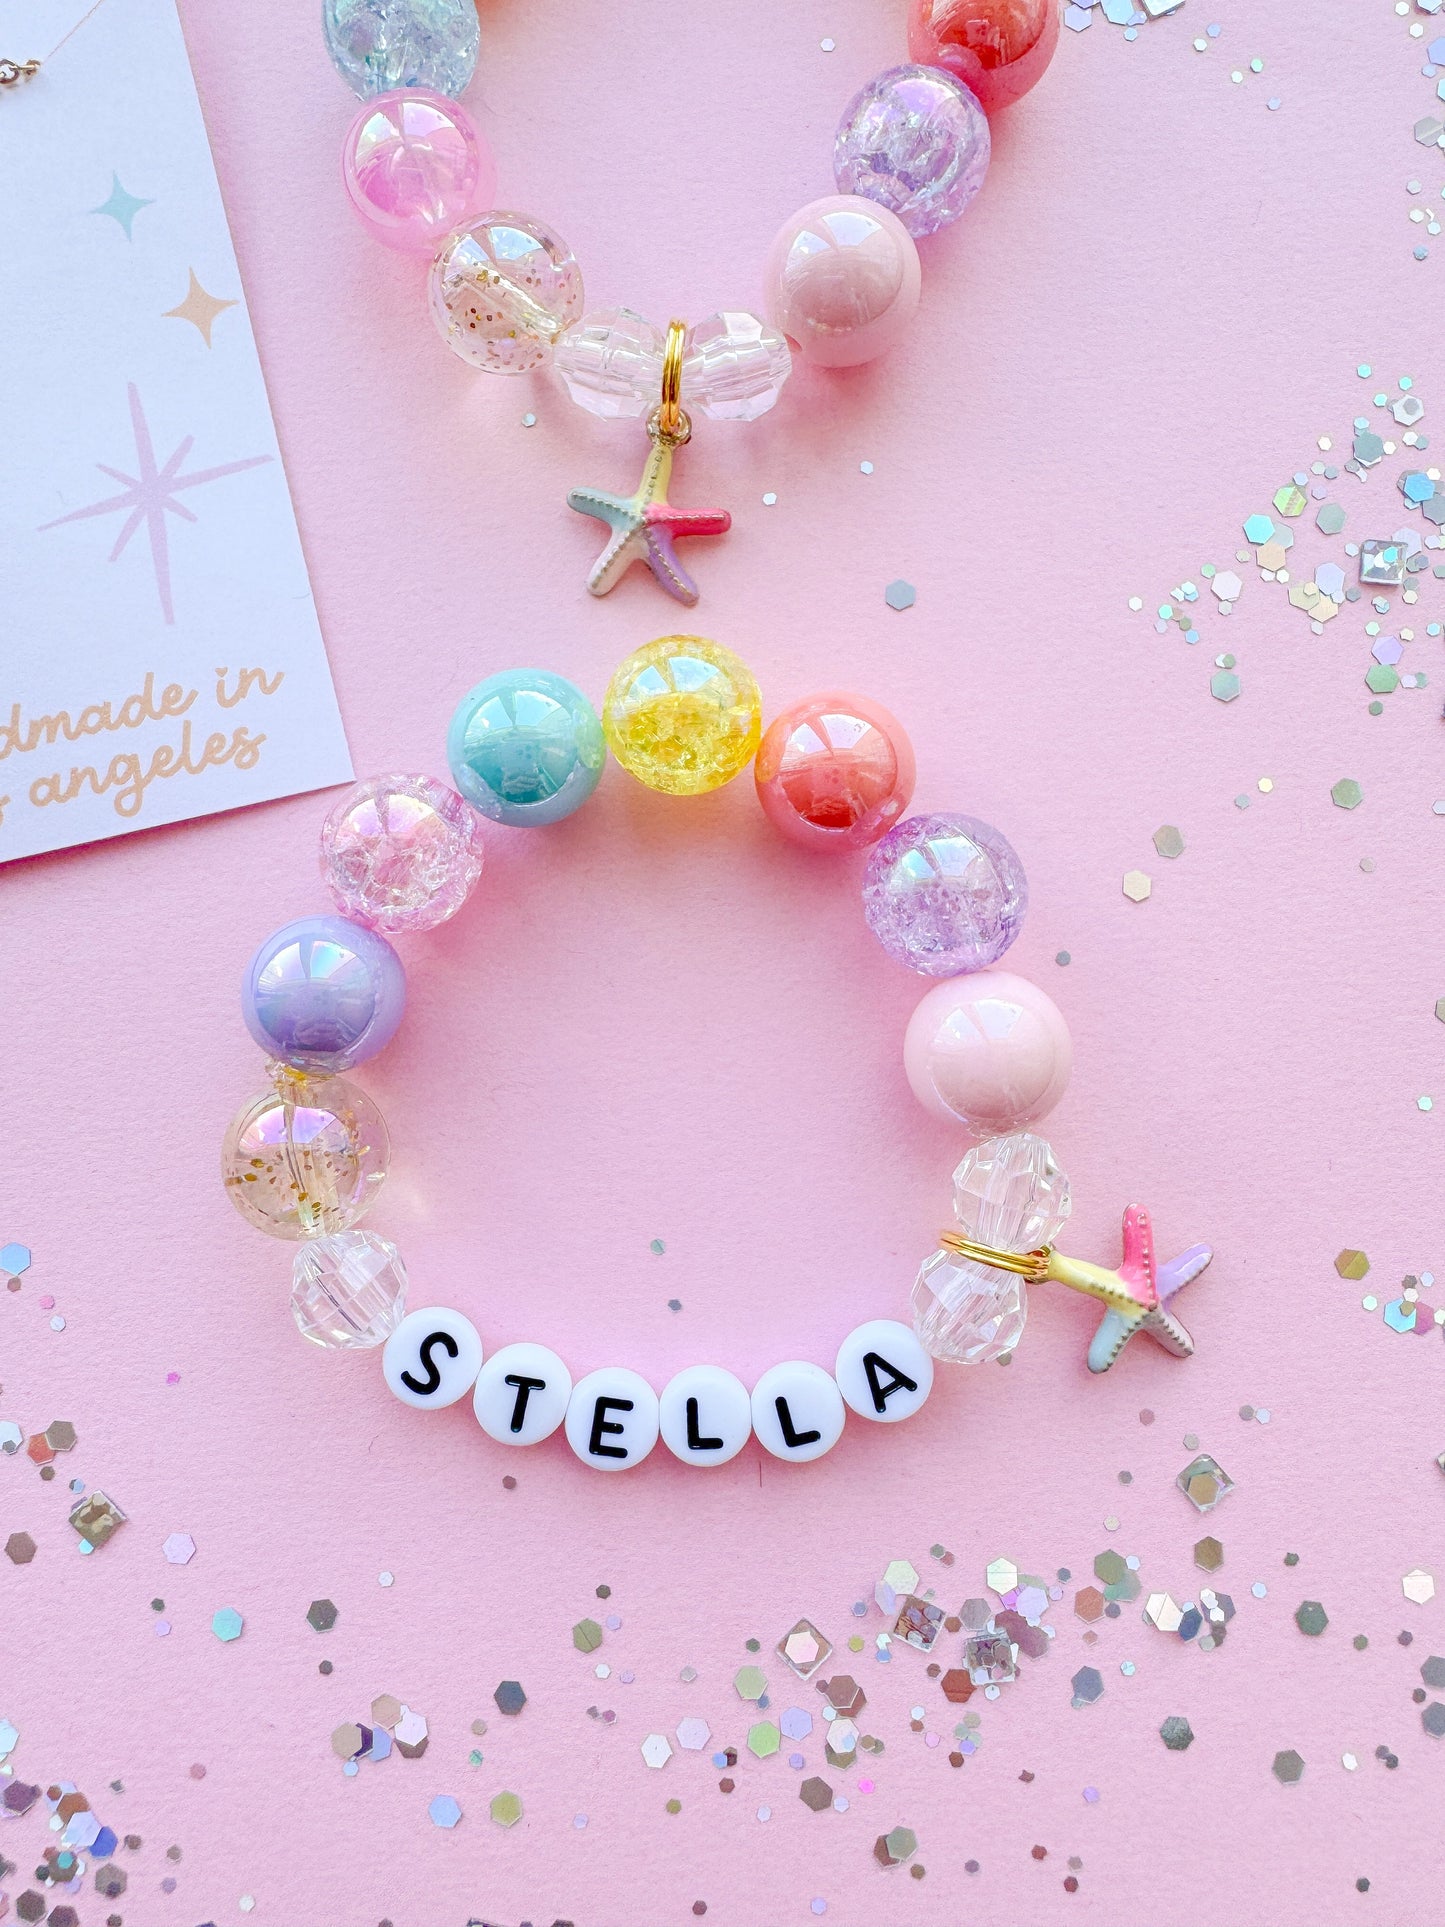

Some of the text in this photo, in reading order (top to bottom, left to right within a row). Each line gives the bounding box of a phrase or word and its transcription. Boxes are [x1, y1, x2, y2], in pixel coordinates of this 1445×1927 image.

[215, 667, 285, 708] in
[29, 720, 267, 818] angeles
[400, 1331, 918, 1459] STELLA
